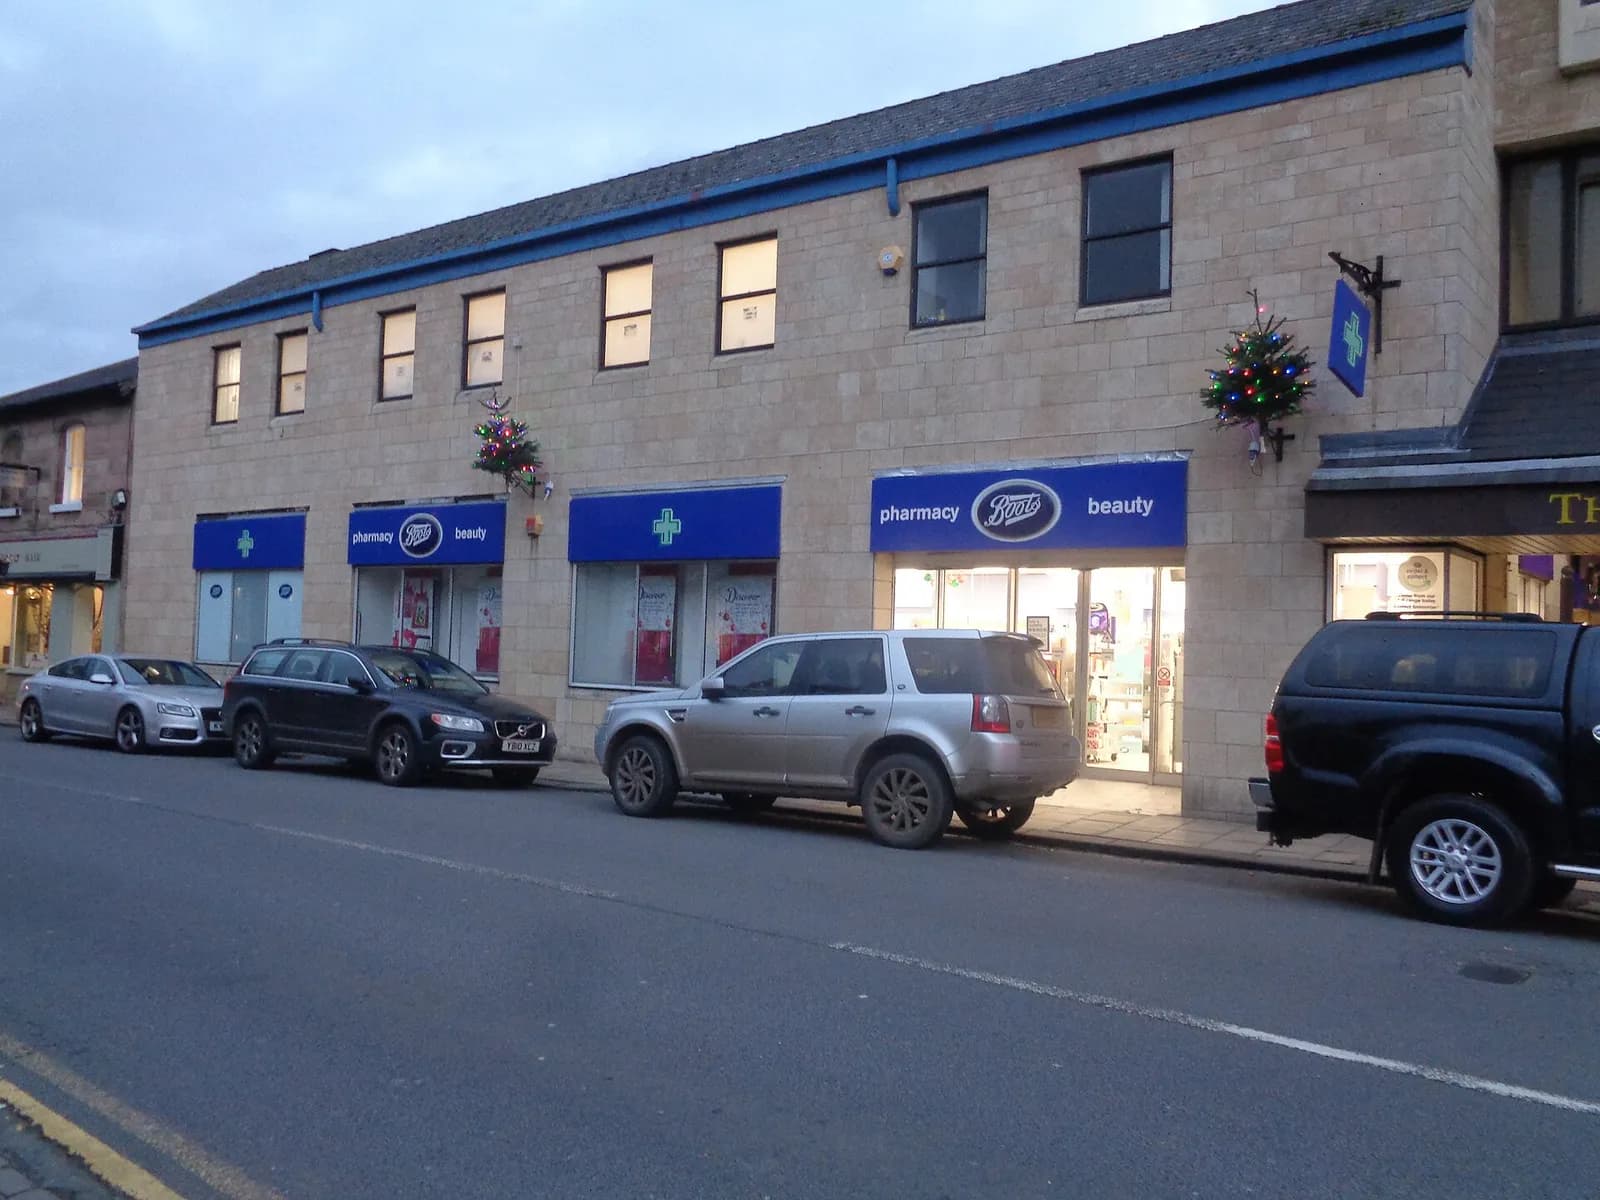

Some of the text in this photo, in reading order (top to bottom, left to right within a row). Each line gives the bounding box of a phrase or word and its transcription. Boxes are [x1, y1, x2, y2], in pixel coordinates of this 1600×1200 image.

[879, 492, 1154, 527] pharmacy Boots beauty
[352, 523, 487, 547] pharmacy Boots beauty
